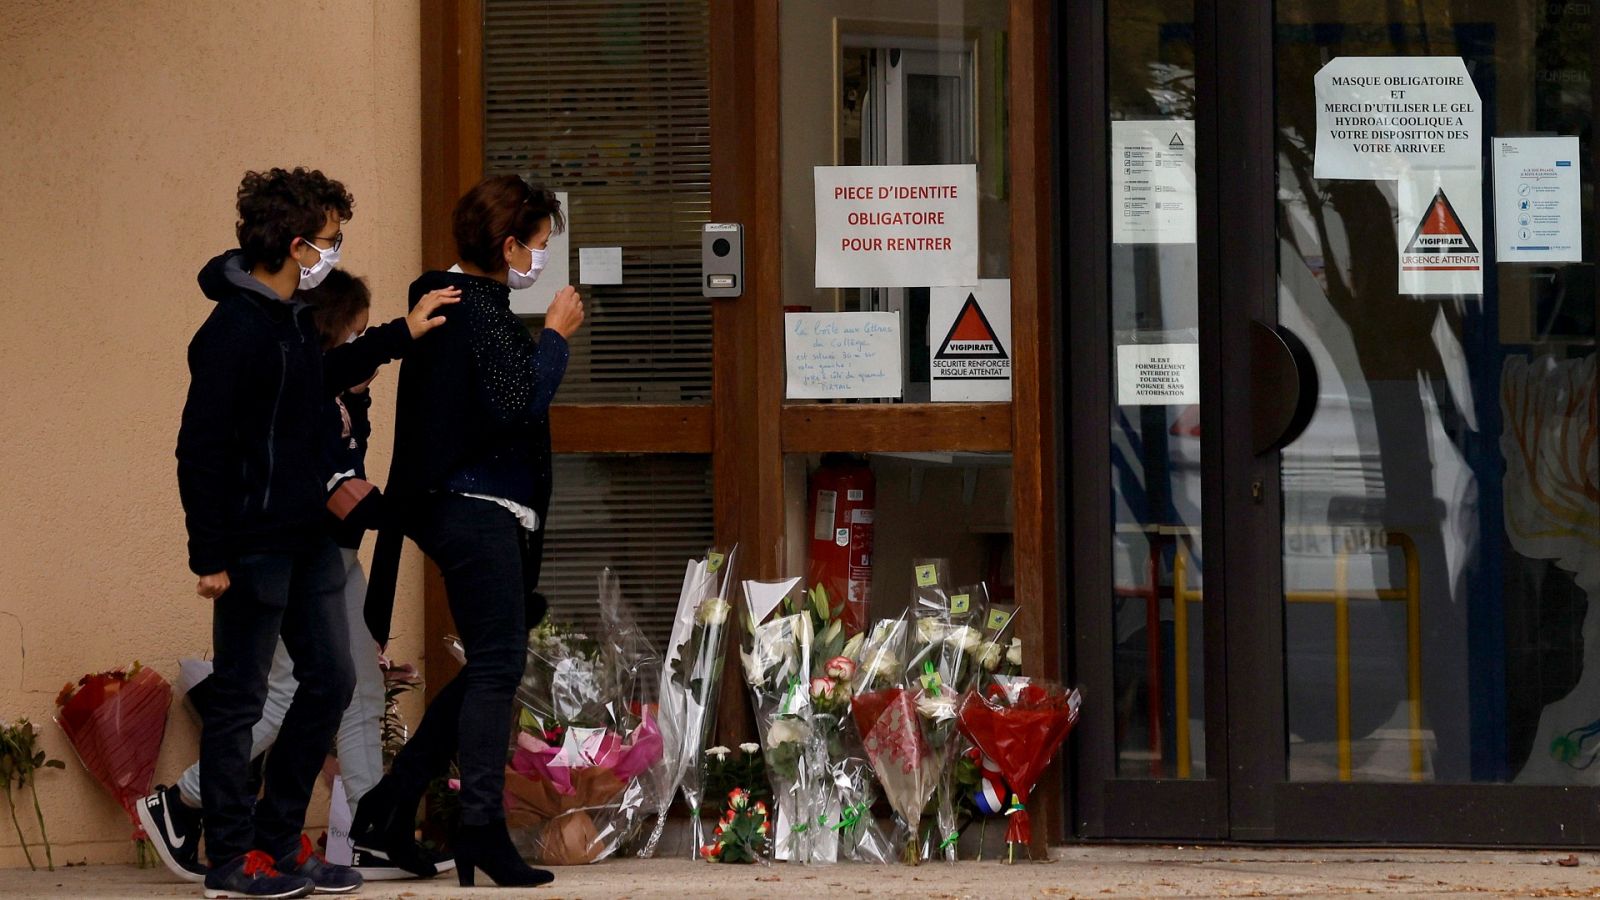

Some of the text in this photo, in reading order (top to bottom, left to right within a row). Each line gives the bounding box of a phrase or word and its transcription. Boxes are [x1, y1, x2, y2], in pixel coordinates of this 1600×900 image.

[1332, 76, 1464, 87] MASQUE OBLIGATOIRE
[1391, 90, 1406, 99] ET
[1325, 103, 1361, 113] MERCI
[1433, 104, 1448, 113] LE
[1450, 103, 1474, 113] GEL
[1335, 117, 1463, 128] HYDROALCOOLIQUE A
[1331, 130, 1469, 140] VOTRE DISPOSITION DES
[1353, 143, 1446, 153] VOTRE ARRIVEE
[834, 186, 874, 200] PIECE
[848, 212, 945, 225] OBLIGATOIRE
[842, 238, 952, 251] POUR RENTRER
[1402, 255, 1479, 264] URGENCE ATTENTAT
[940, 368, 968, 376] RISQUE
